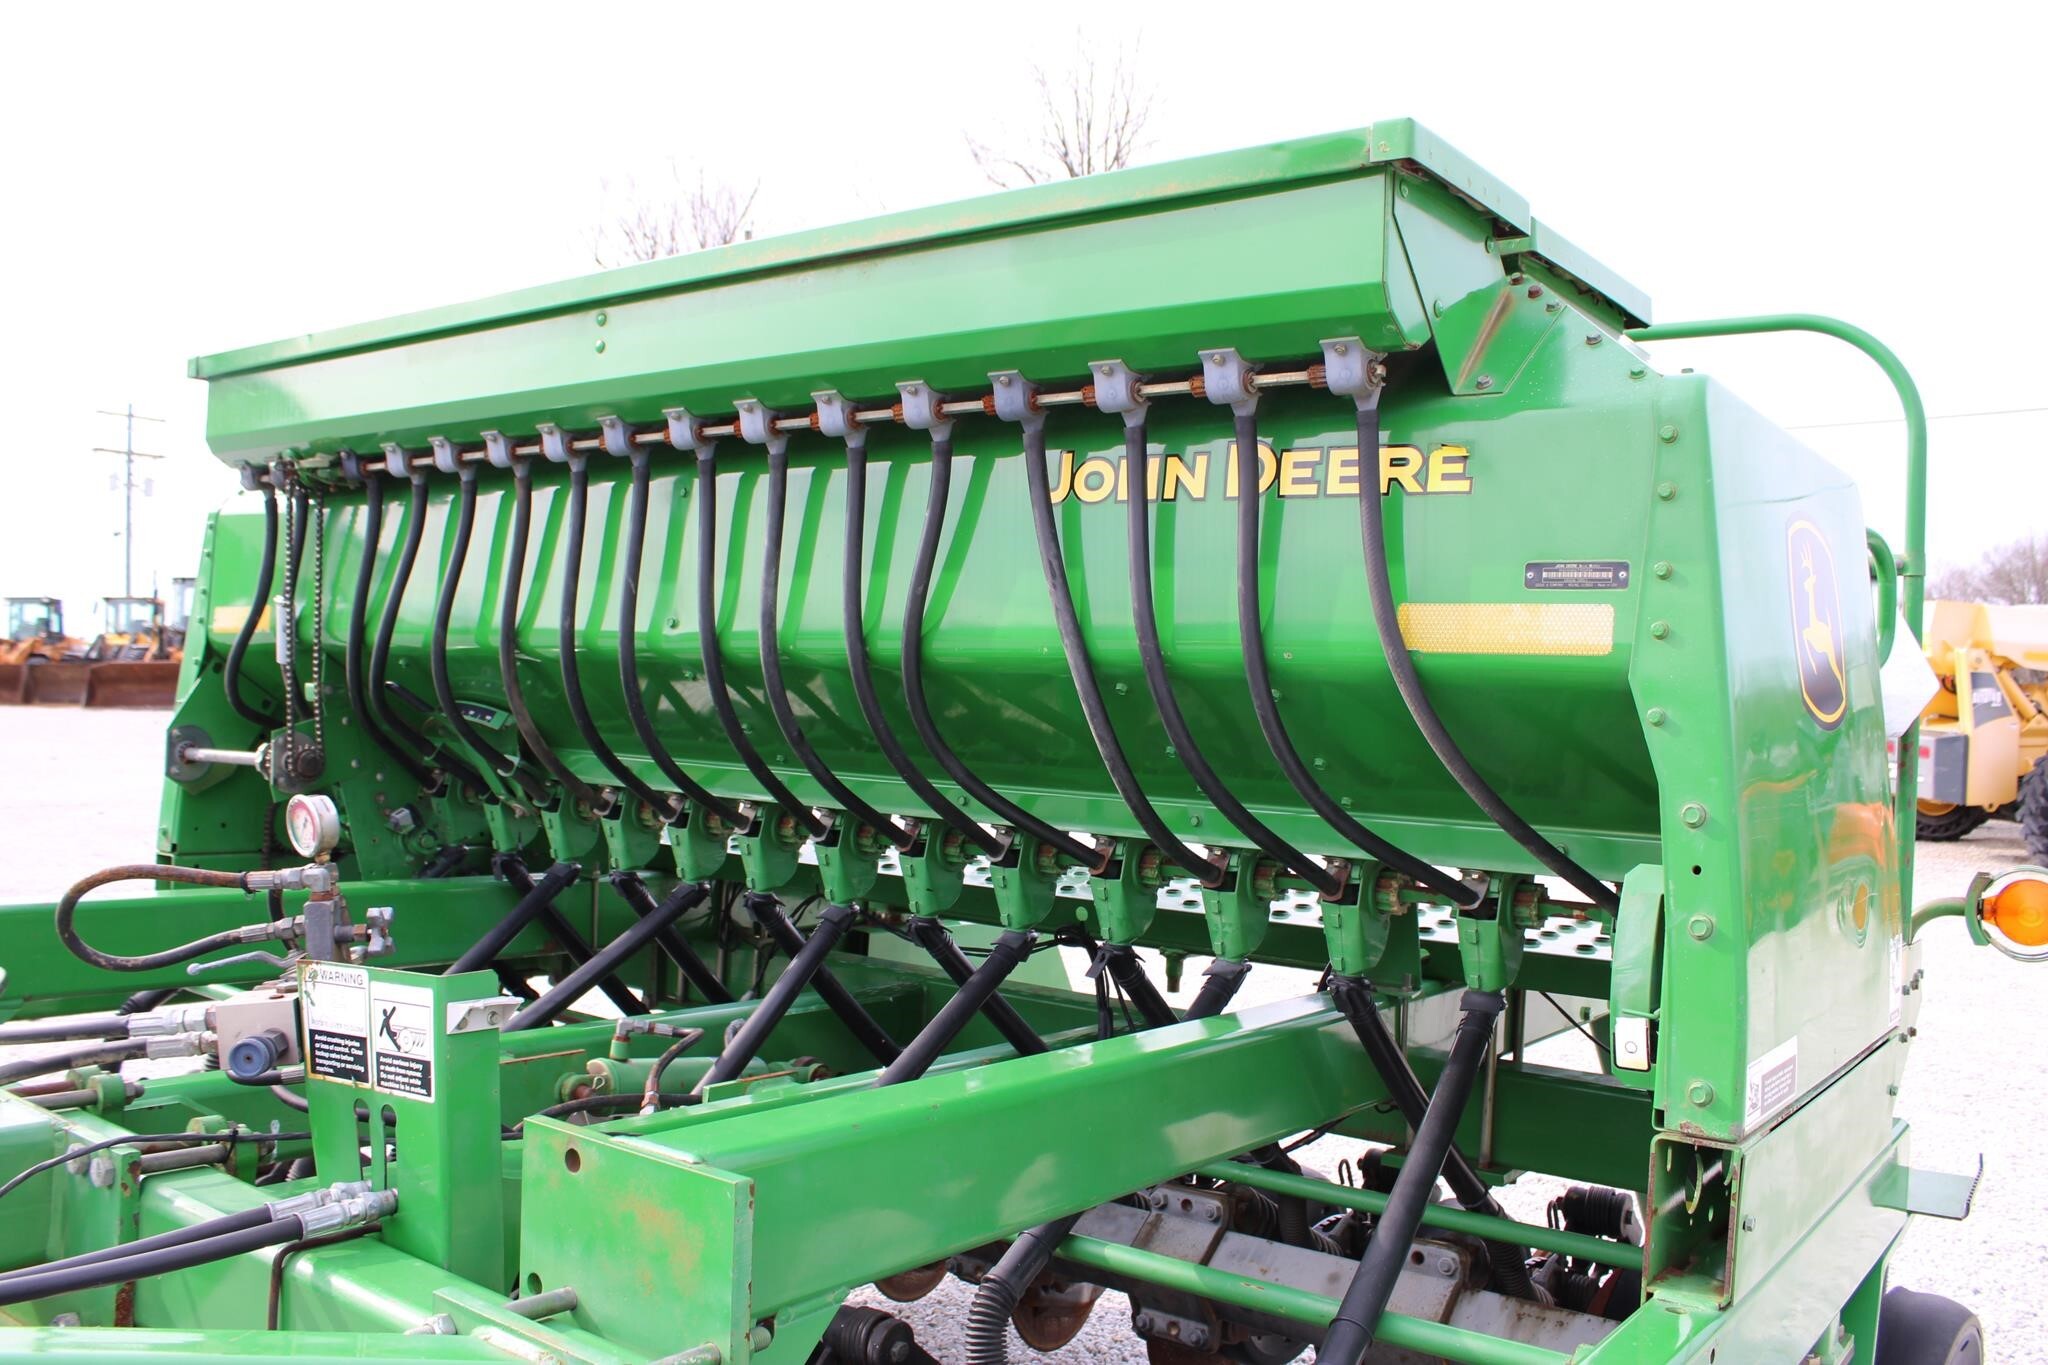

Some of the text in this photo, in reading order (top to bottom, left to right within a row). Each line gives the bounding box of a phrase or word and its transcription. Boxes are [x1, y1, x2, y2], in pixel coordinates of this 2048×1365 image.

[1048, 440, 1475, 505] JOHN DEERE
[320, 969, 364, 986] WARNING
